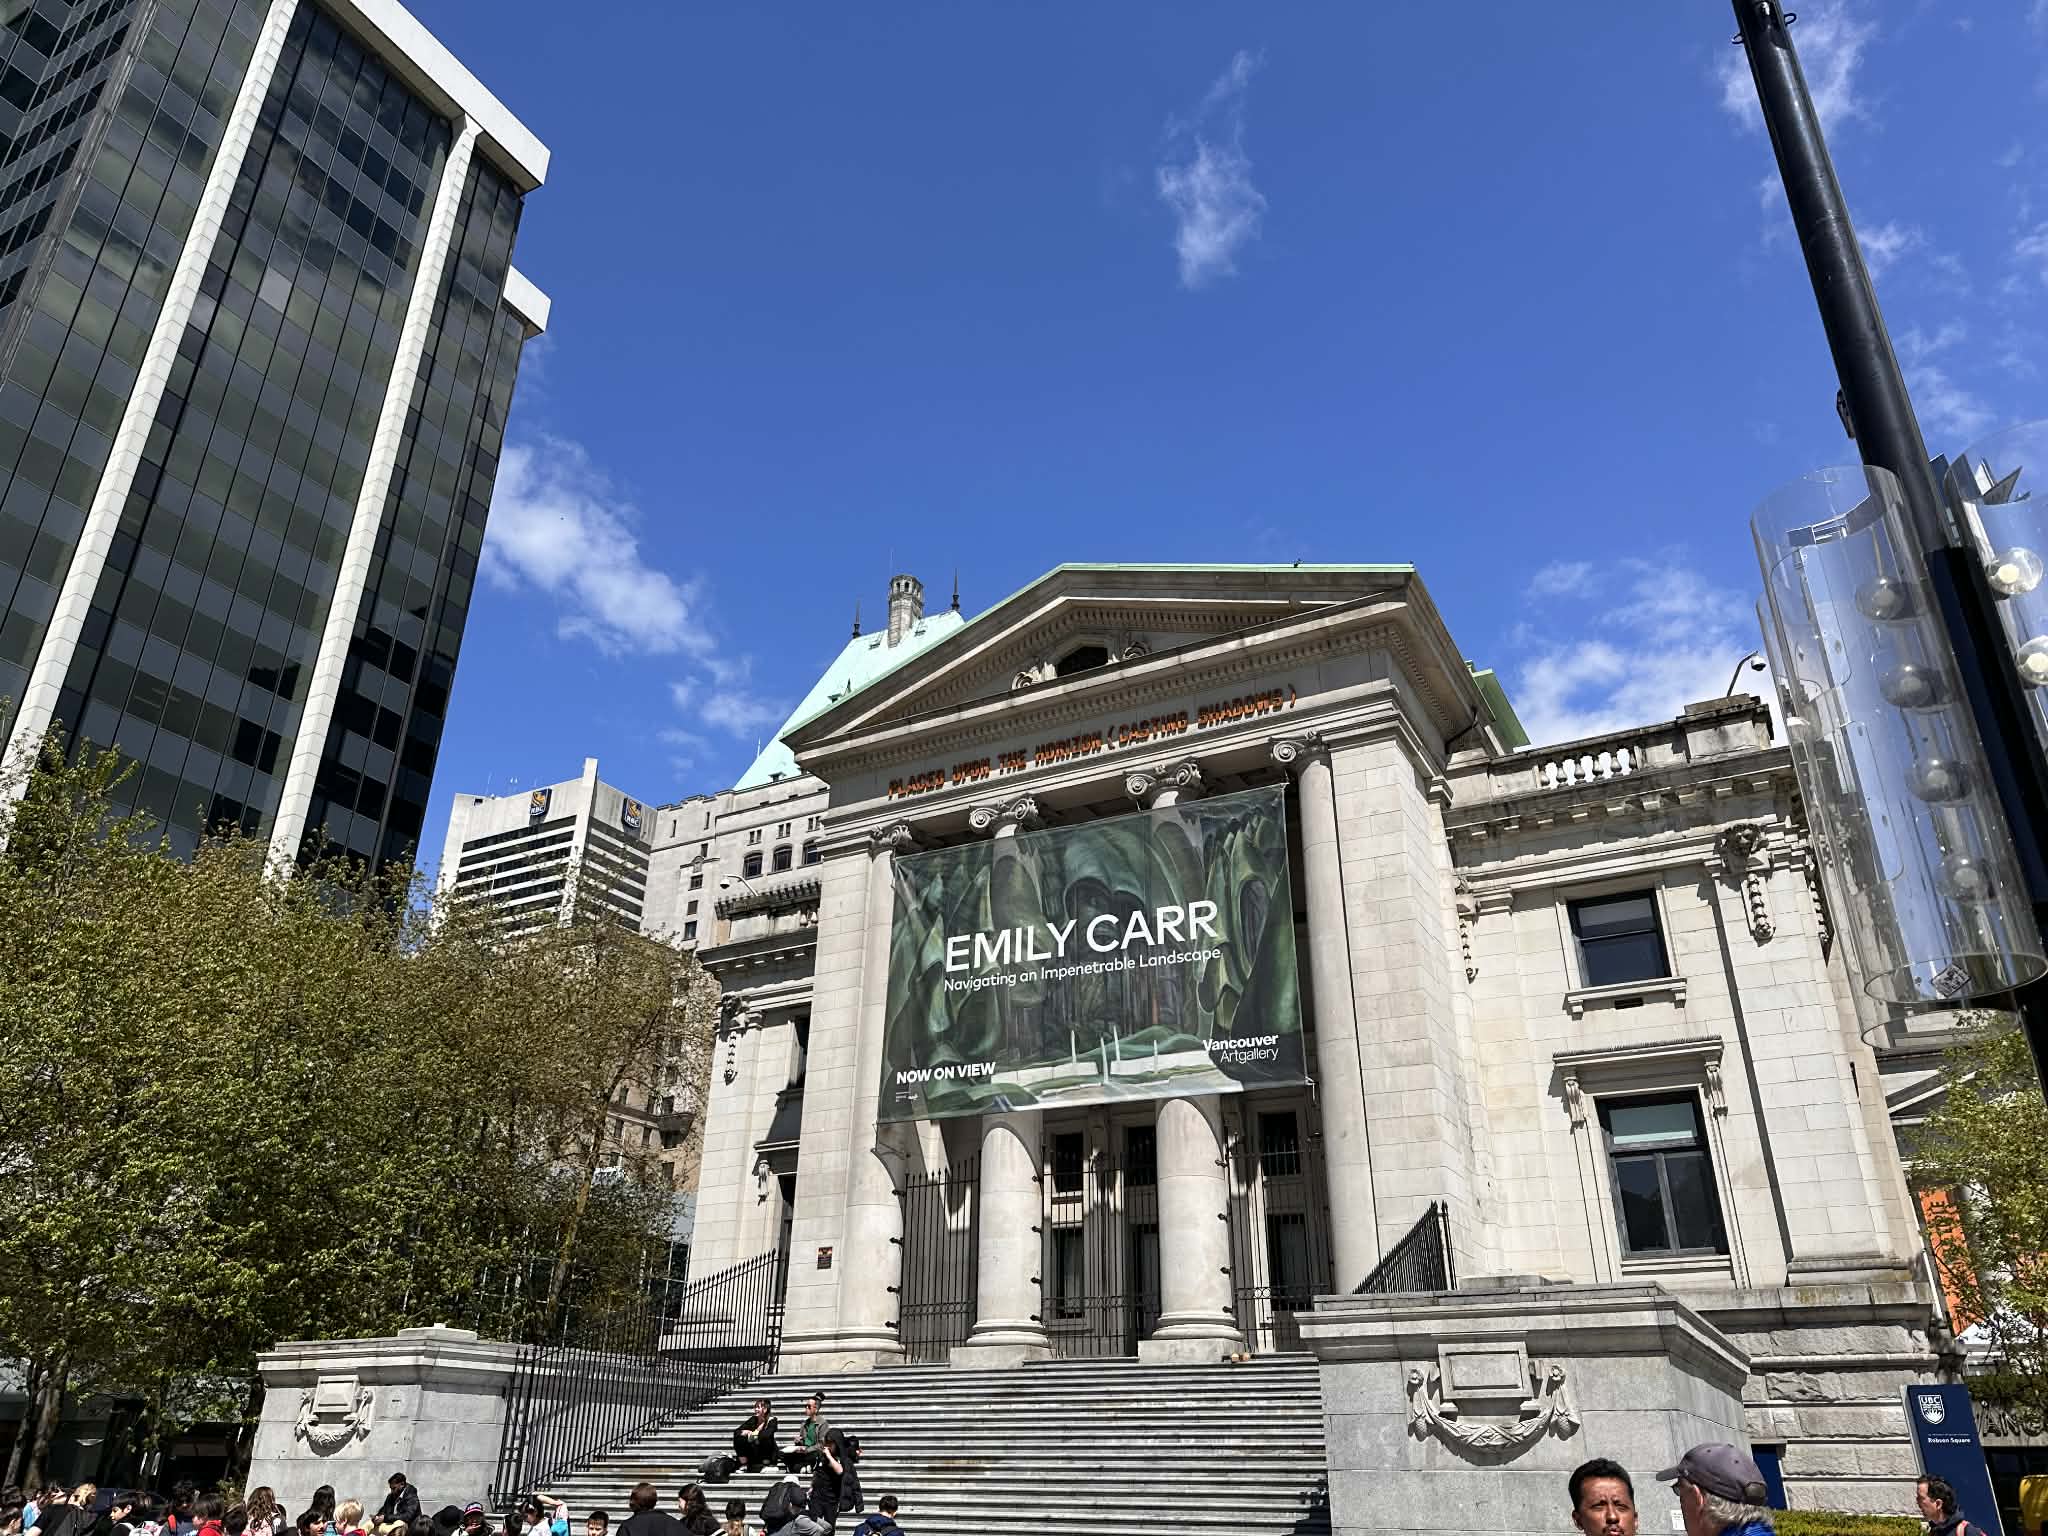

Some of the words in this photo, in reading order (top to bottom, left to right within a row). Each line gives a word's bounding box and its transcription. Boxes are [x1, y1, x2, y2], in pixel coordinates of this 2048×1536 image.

[888, 769, 945, 799] PLACED
[952, 757, 992, 786] UPON
[998, 748, 1027, 775] THE
[1035, 730, 1103, 768] HORIZON
[946, 918, 1078, 972] EMILY
[1086, 900, 1218, 953] CARR
[944, 971, 1017, 992] Navigating
[1020, 971, 1037, 982] an
[1041, 955, 1136, 981] Impenetrable
[1139, 947, 1221, 968] Landscape
[1203, 1034, 1279, 1051] Vancouver
[1220, 1047, 1279, 1064] Artgallery
[896, 1068, 932, 1084] NOW
[933, 1066, 955, 1080] ON
[957, 1061, 996, 1078] VIEW
[1921, 1396, 1940, 1404] UBC
